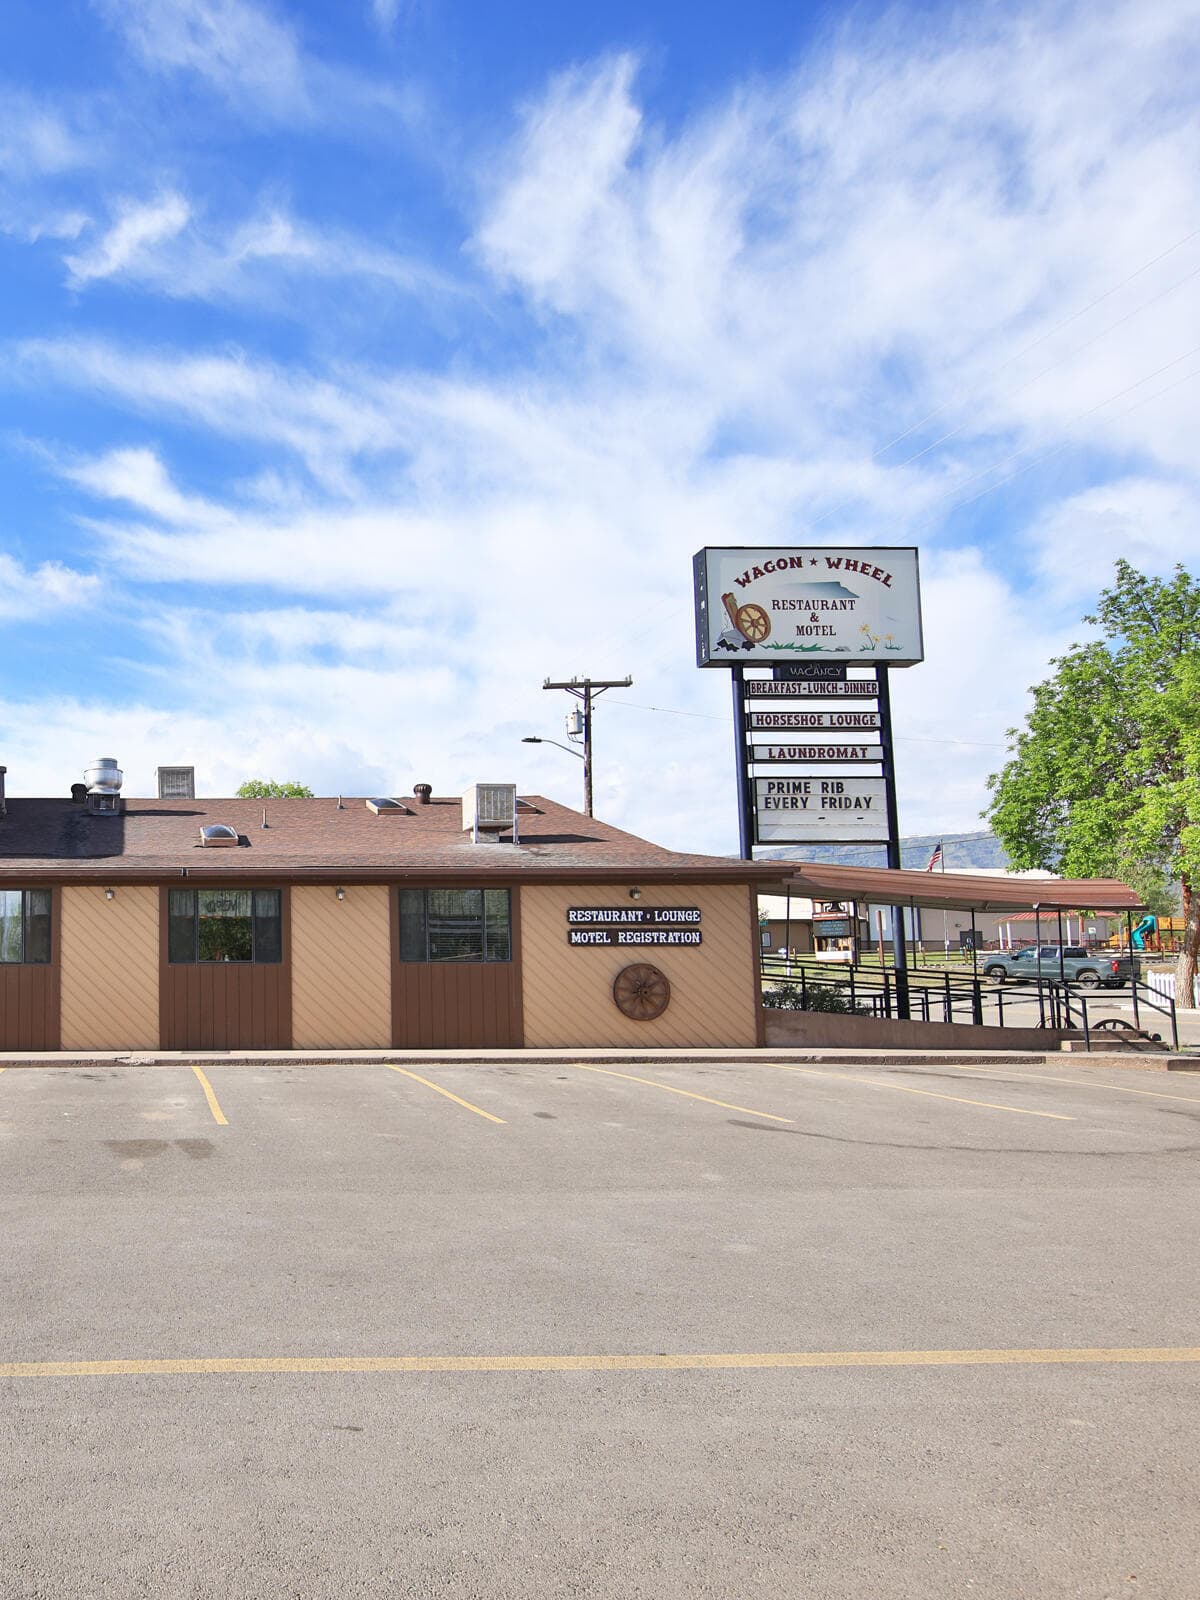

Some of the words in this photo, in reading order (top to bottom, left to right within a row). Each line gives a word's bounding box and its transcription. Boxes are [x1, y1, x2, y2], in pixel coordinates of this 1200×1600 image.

[734, 556, 804, 589] WAGON
[825, 556, 894, 588] WHEEL
[772, 599, 856, 611] RESTAURANT
[809, 612, 820, 623] &
[796, 625, 837, 636] MOTEL
[790, 667, 842, 676] VACANCY
[756, 714, 824, 726] HORSESHOE
[829, 714, 876, 726] LOUNGE
[768, 747, 868, 759] LAUNDROMAT
[767, 782, 812, 794] PRIME
[821, 782, 845, 794] RIB
[764, 796, 809, 809] EVERY
[821, 796, 873, 809] FRIDAY
[569, 910, 644, 922] RESTAURANT
[654, 910, 701, 922] LOUNGE
[571, 931, 612, 943] MOTEL
[618, 931, 700, 943] REGISTRATION
